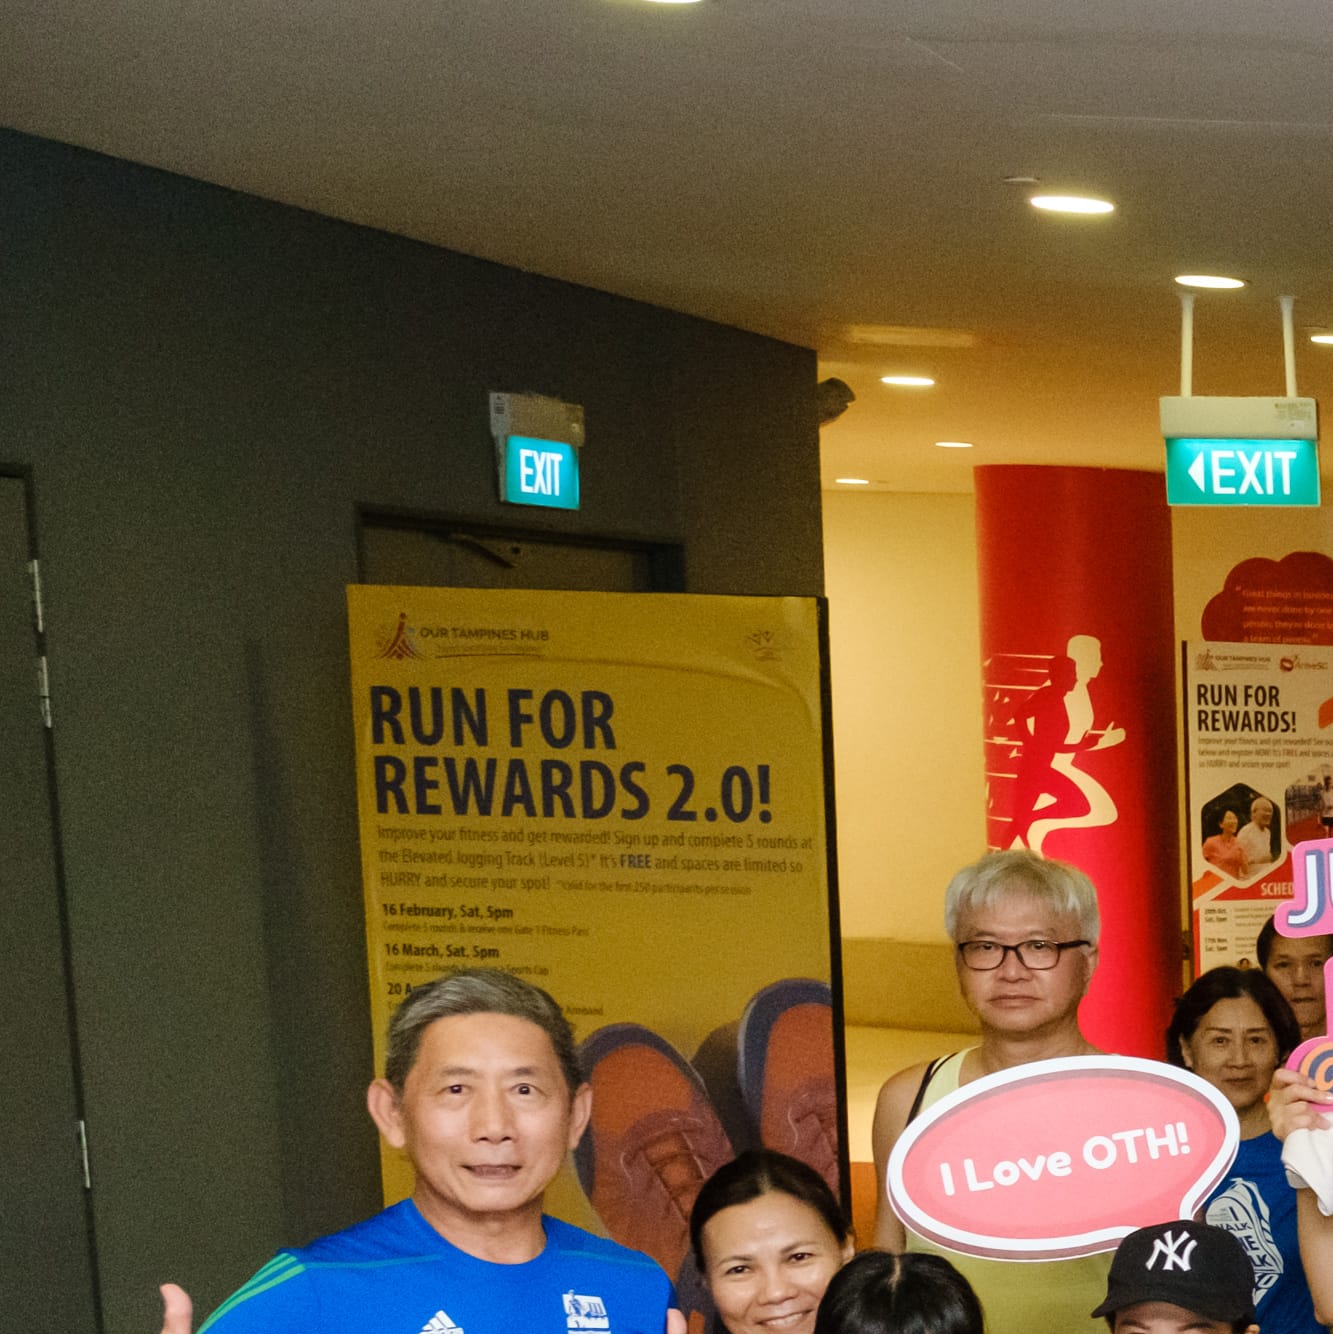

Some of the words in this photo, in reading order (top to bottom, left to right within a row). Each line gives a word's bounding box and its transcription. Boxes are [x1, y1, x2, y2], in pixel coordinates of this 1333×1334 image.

[520, 448, 563, 496] EXIT
[1211, 450, 1297, 495] EXIT
[420, 627, 449, 638] OUR
[452, 628, 518, 640] TAMPINES
[520, 629, 549, 641] HUB
[1197, 683, 1237, 706] RUN
[1244, 685, 1280, 707] FOR
[370, 685, 490, 747] RUN
[508, 688, 617, 750] FOR
[1197, 709, 1297, 733] REWARDS!
[374, 755, 650, 821] REWARDS
[666, 763, 772, 823] 2.0!
[377, 827, 427, 842] Improve
[429, 829, 456, 842] your
[459, 828, 499, 841] fitness
[502, 828, 524, 842] and
[527, 830, 548, 845] get
[551, 830, 611, 845] rewarded!
[614, 831, 641, 848] Sign
[644, 835, 659, 848] up
[662, 833, 685, 848] and
[688, 834, 743, 850] complete
[746, 835, 754, 848] 5
[757, 835, 798, 849] rounds
[801, 837, 813, 850] at
[380, 871, 420, 888] HURRY
[424, 873, 447, 888] and
[450, 875, 488, 888] secure
[491, 877, 516, 892] your
[520, 876, 550, 891] spot!
[1261, 882, 1293, 896] SCHED
[382, 903, 397, 916] 16
[400, 904, 457, 919] February,
[460, 905, 484, 919] Sat,
[487, 906, 513, 920] 5pm
[386, 943, 400, 956] 16
[402, 943, 443, 958] March,
[446, 944, 470, 958] Sat,
[473, 945, 500, 960] 5pm
[387, 983, 402, 995] 20
[939, 1161, 955, 1196] I
[964, 1150, 1073, 1192] Love
[1082, 1121, 1191, 1170] OTH!
[1145, 1230, 1198, 1272] NY
